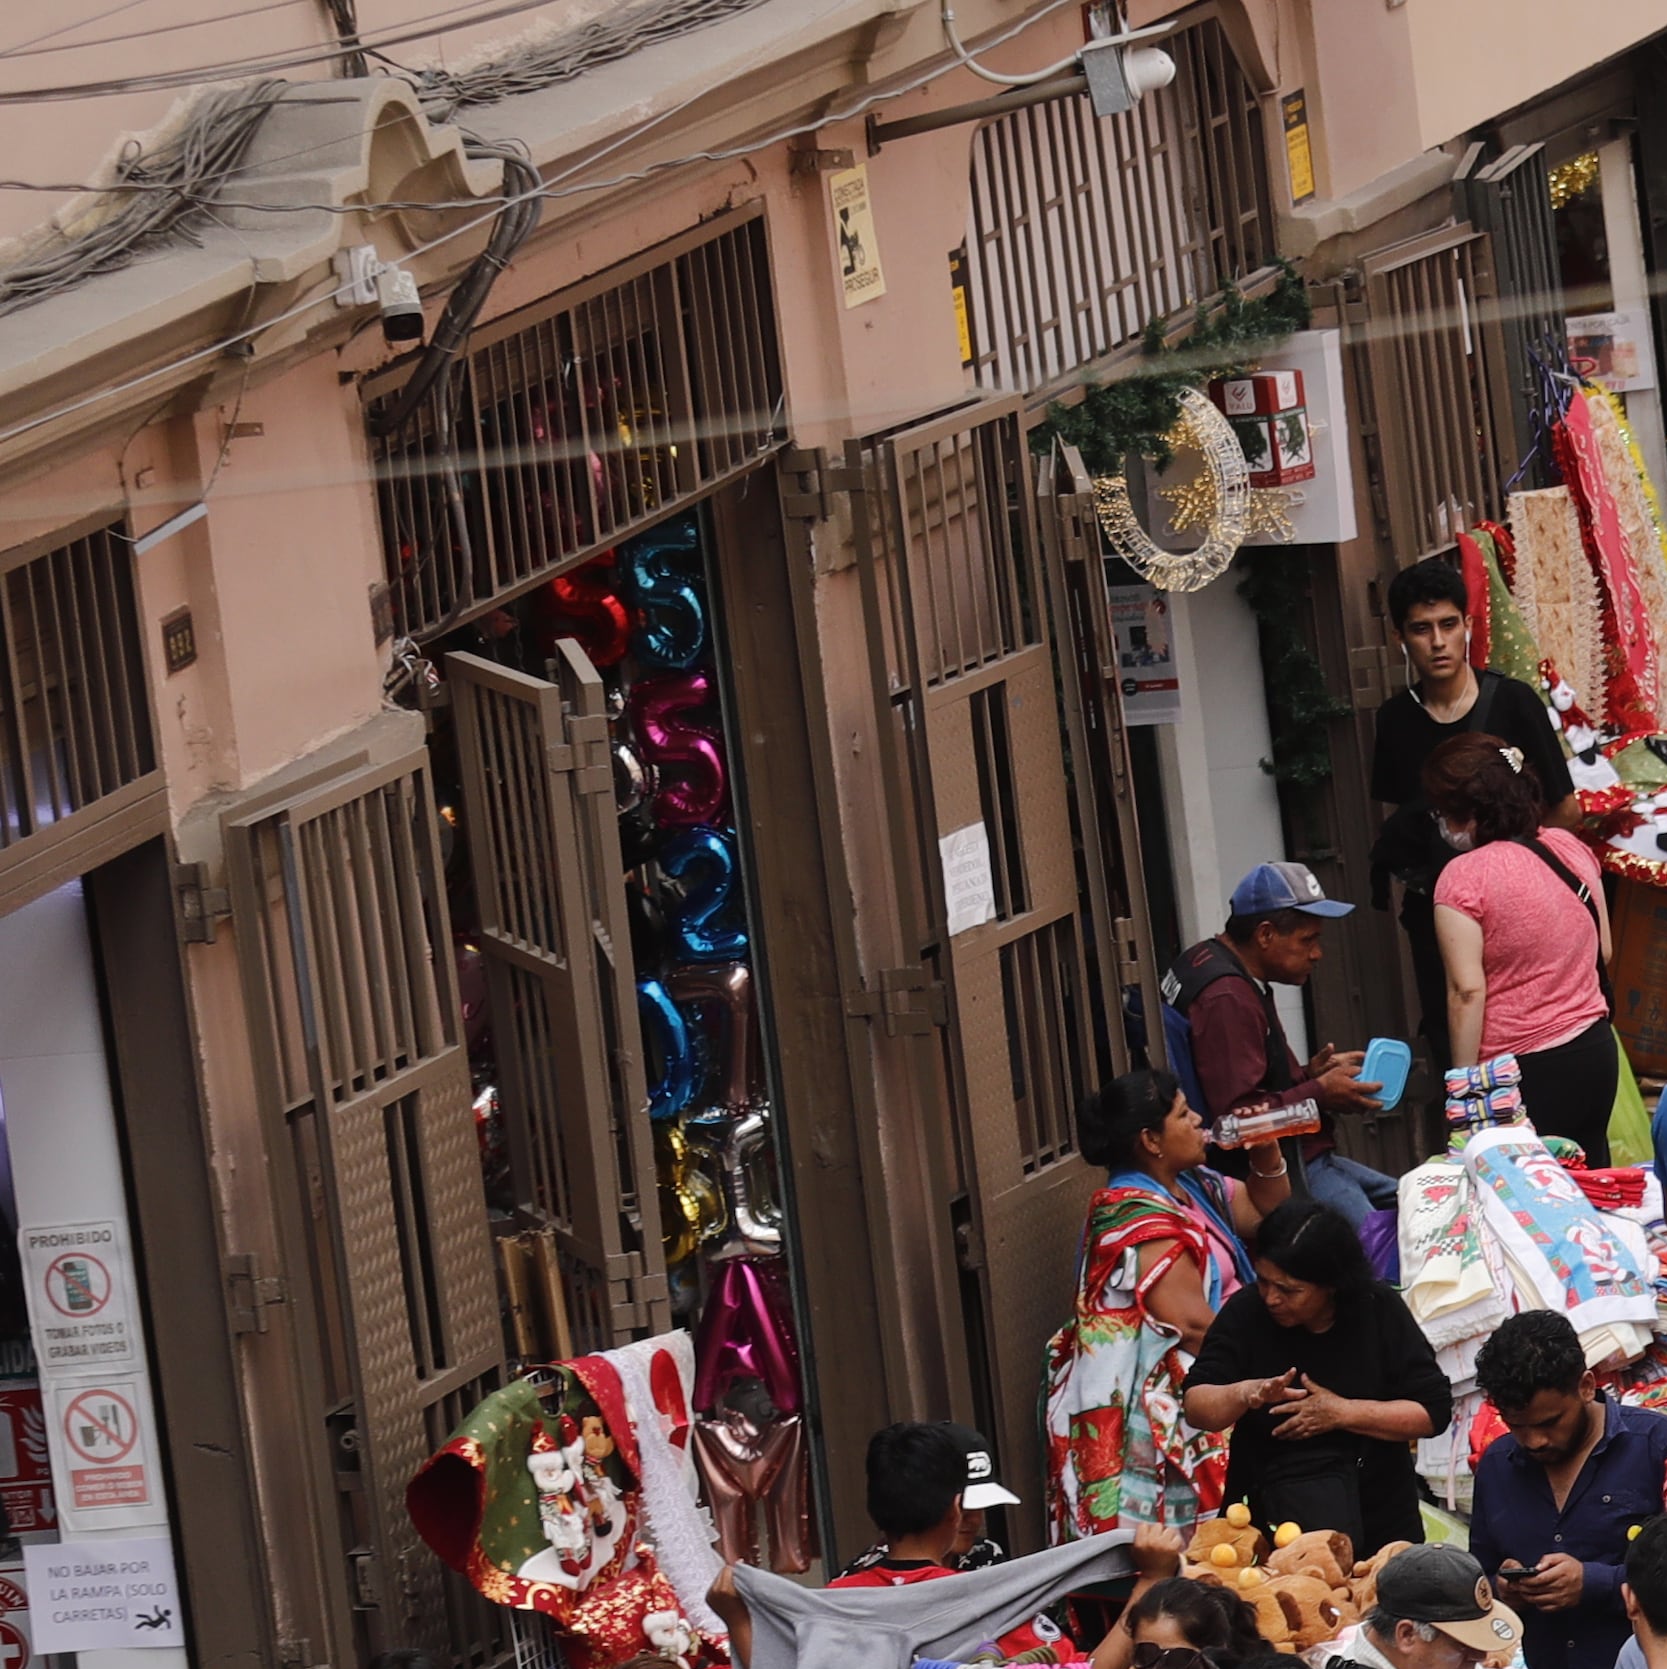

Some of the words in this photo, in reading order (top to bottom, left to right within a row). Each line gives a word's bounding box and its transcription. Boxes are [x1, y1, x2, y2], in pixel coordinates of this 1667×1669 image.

[29, 1231, 113, 1251] PROHIBIDO
[45, 1325, 81, 1340] TOMAR
[82, 1322, 115, 1338] FOTOS
[49, 1341, 87, 1360] GRABAR
[47, 1563, 64, 1578] NO
[68, 1561, 116, 1577] BAJAR
[119, 1560, 150, 1574] POR
[50, 1588, 67, 1602] LA
[71, 1585, 122, 1601] RAMPA
[125, 1582, 167, 1600] (SOLO
[52, 1606, 130, 1625] CARRETAS)
